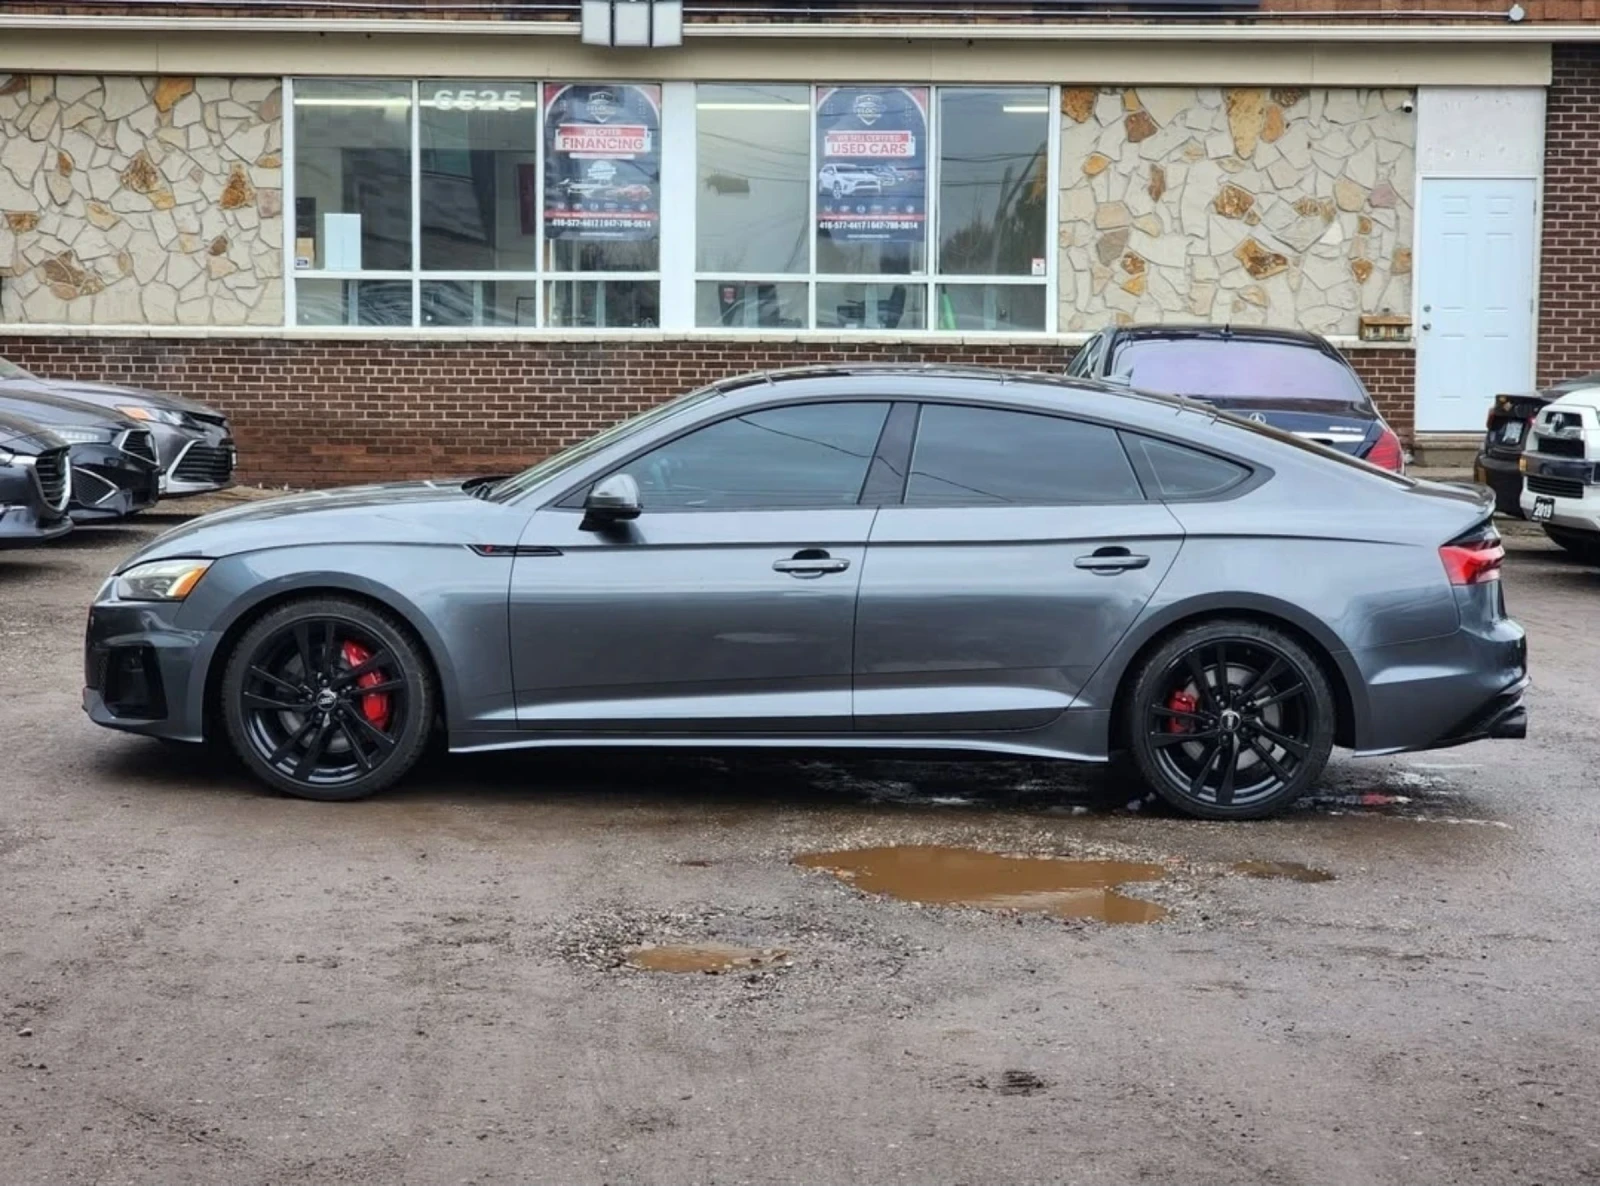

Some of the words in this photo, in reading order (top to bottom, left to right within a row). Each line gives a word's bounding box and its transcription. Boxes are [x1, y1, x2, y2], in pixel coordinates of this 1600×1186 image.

[433, 89, 522, 111] 6525
[562, 137, 644, 150] FINANCING
[831, 143, 867, 154] USED
[869, 143, 908, 154] CARS
